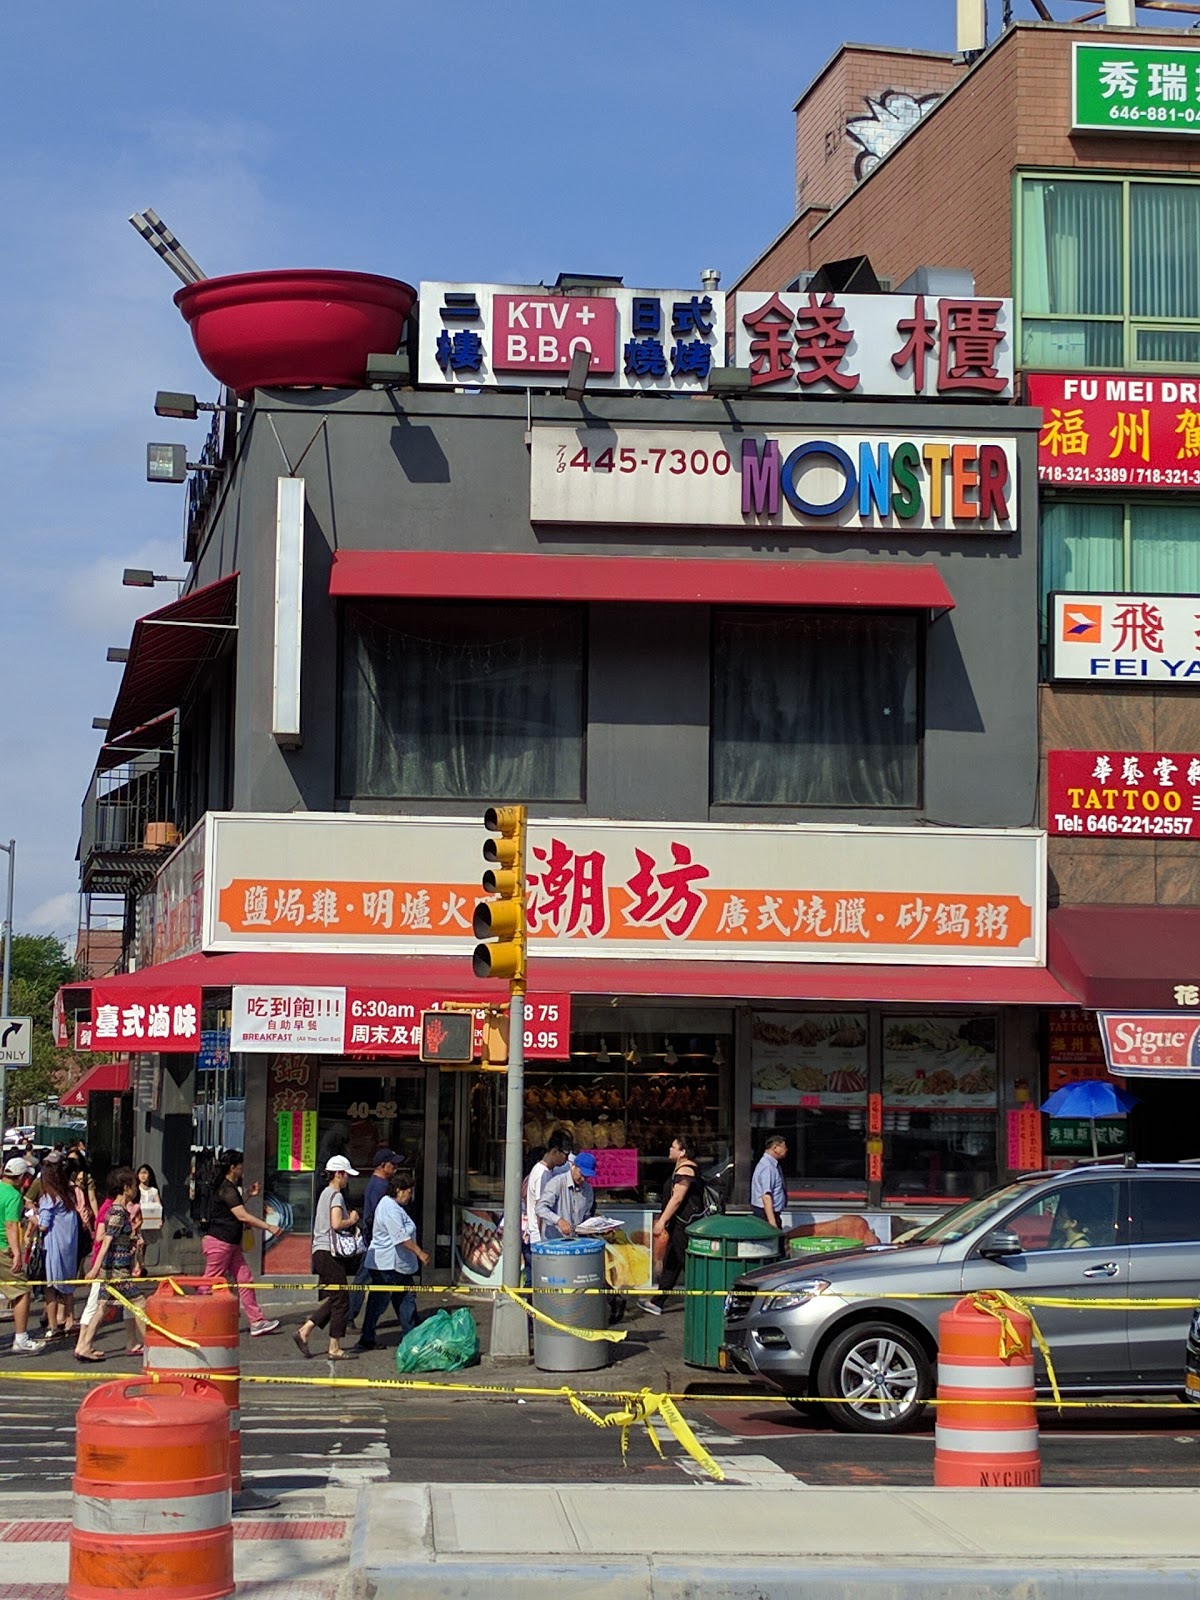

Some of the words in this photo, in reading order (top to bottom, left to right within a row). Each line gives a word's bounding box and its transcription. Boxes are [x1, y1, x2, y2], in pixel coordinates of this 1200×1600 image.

[1098, 61, 1200, 102] 秀瑞
[508, 302, 569, 329] KTV
[631, 295, 713, 336] 日式
[742, 291, 1010, 393] 錢櫃
[624, 338, 711, 378] 燒烤
[1064, 379, 1097, 400] FU
[1106, 381, 1153, 402] MEI
[570, 447, 730, 476] 445-7300
[1038, 466, 1127, 482] 718-321-3389
[742, 440, 1010, 521] MONSTER
[1110, 602, 1200, 653] 飛
[1090, 658, 1147, 676] FEI
[1067, 788, 1181, 811] TATTOO
[1054, 814, 1083, 832] Tel:
[1087, 815, 1193, 834] 646-221-2557
[241, 886, 503, 928] 鹽焗雞·明爐火
[1173, 984, 1199, 1005] 花
[96, 1003, 198, 1039] 臺式滷味
[351, 1001, 414, 1018] 6:30am
[242, 1033, 293, 1041] BREAKFAST
[1113, 1022, 1186, 1055] Sigue
[347, 1101, 398, 1119] 40-52
